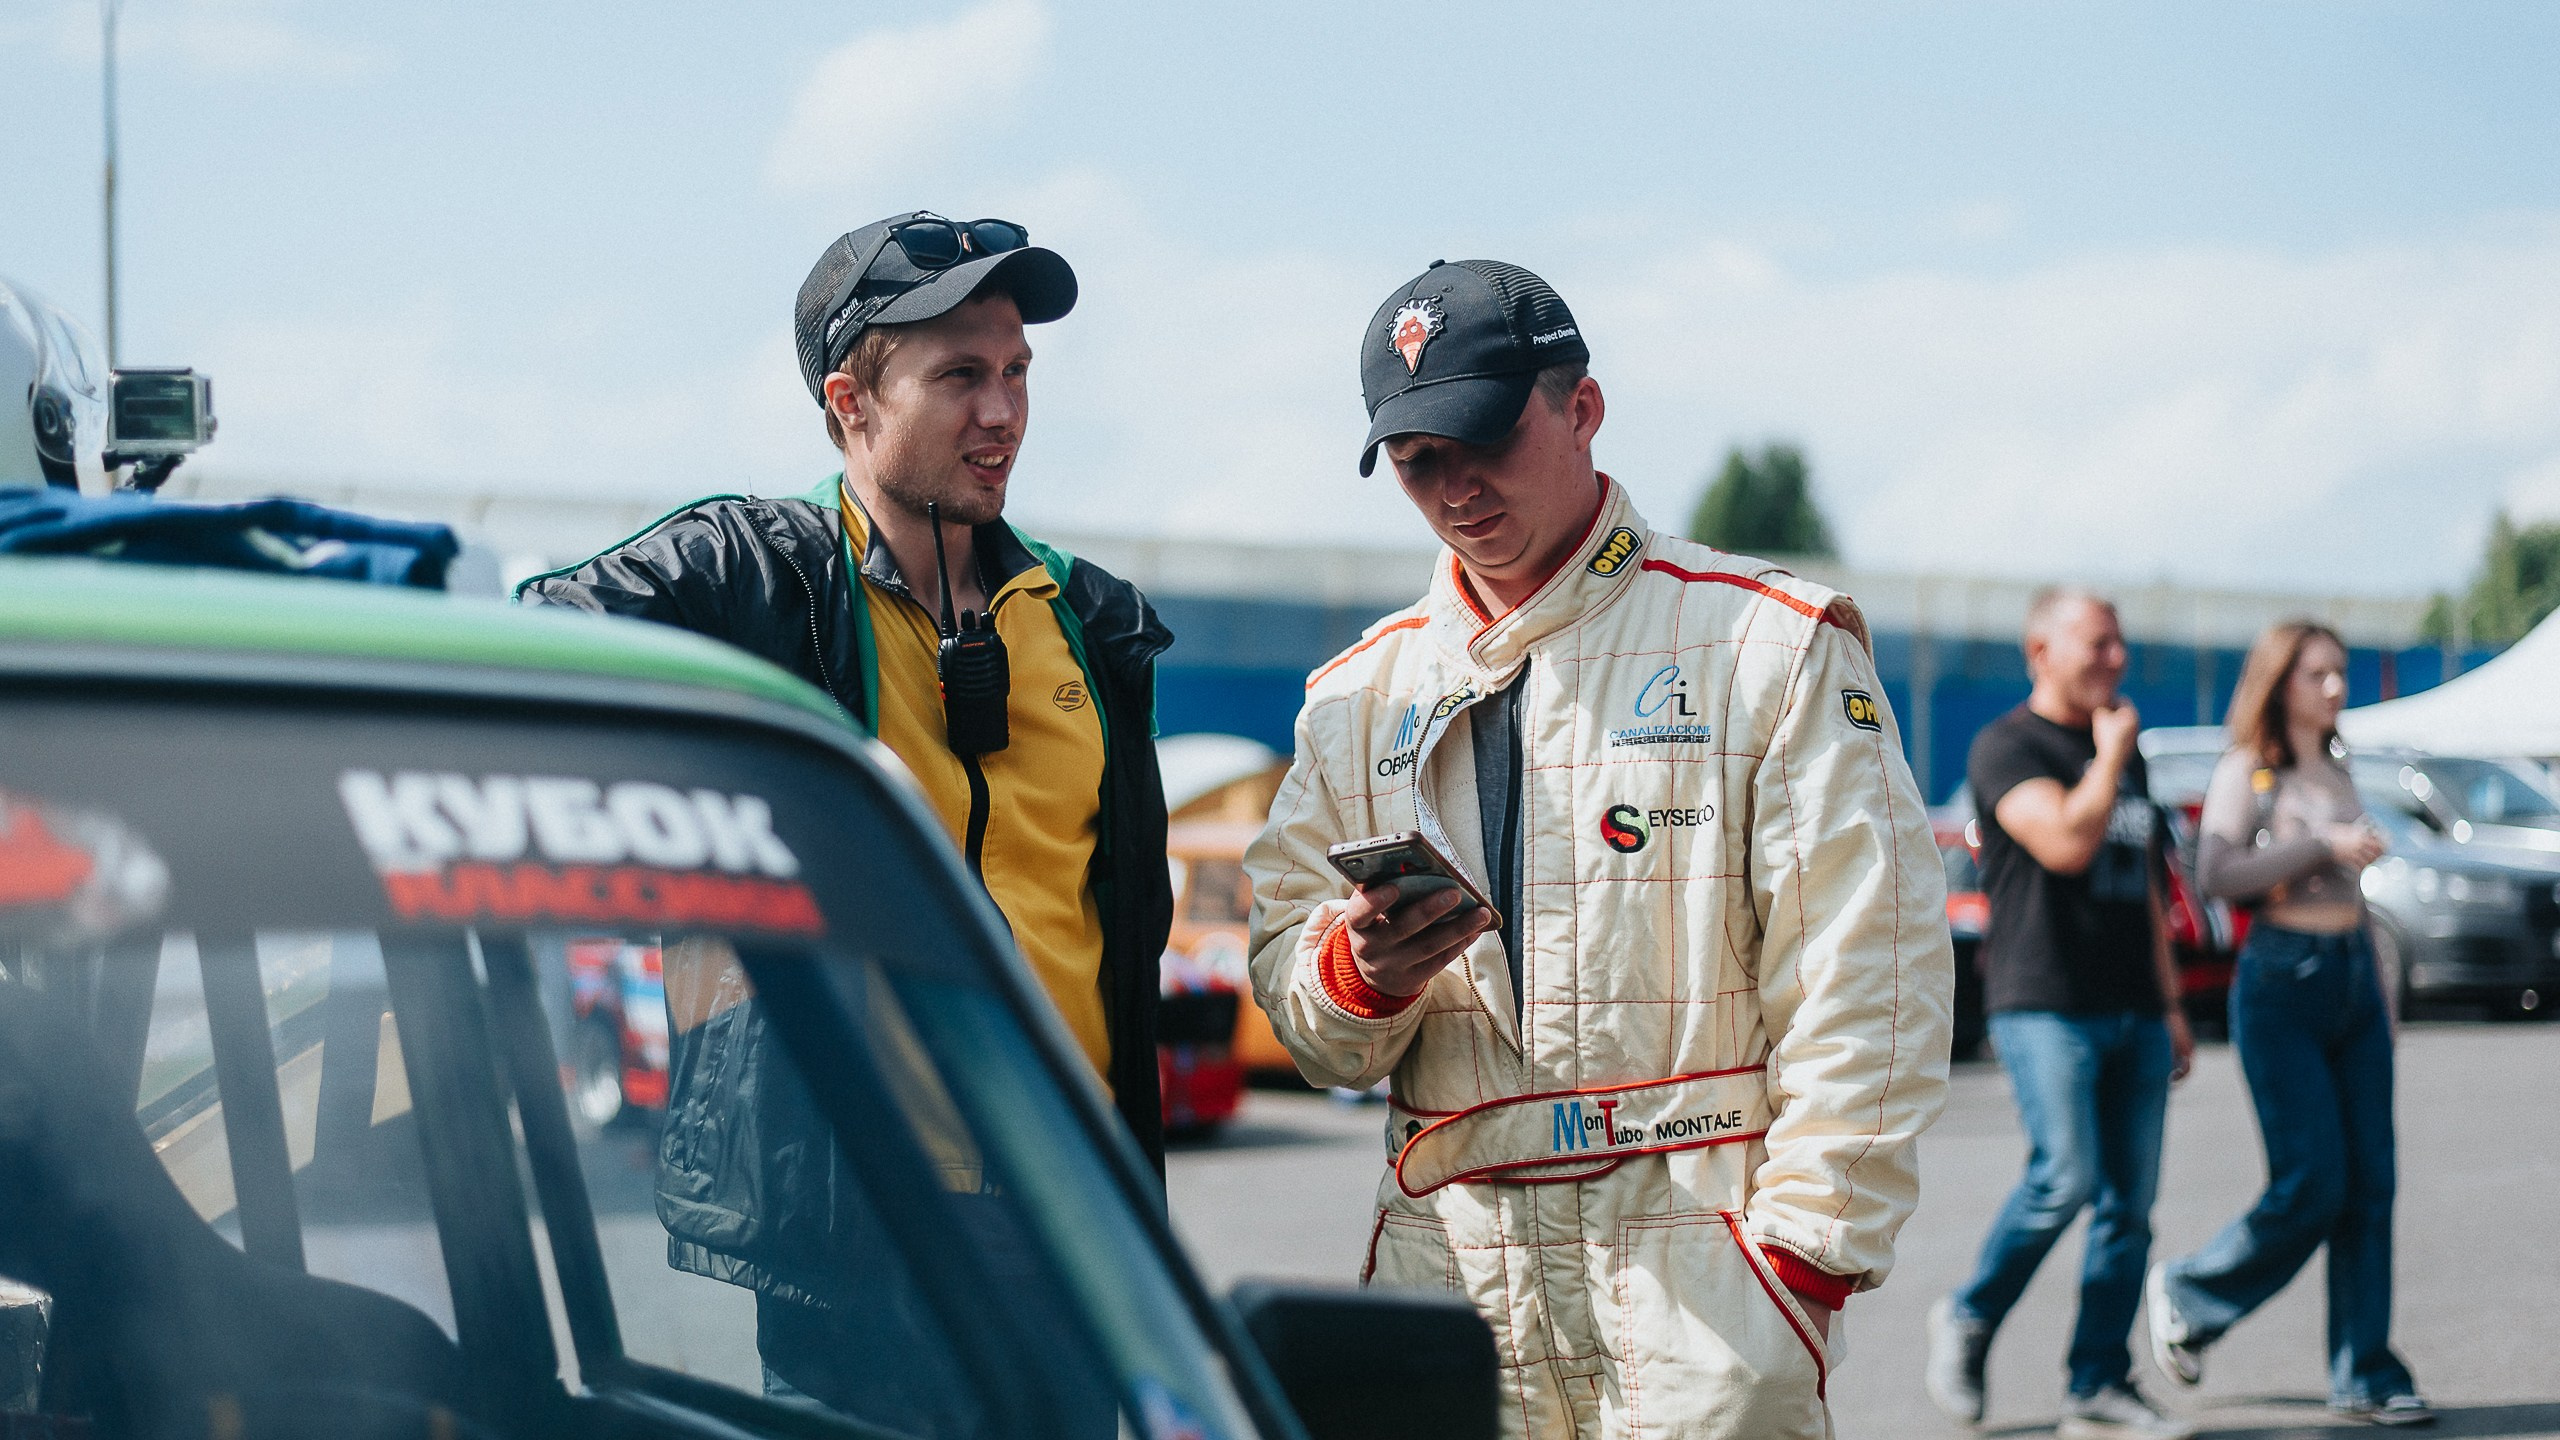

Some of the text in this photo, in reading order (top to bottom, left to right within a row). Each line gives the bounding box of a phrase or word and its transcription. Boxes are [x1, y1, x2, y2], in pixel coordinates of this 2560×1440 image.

[1533, 331, 1558, 344] Project
[1594, 531, 1632, 573] OMP
[1655, 1110, 1742, 1141] MONTAJE
